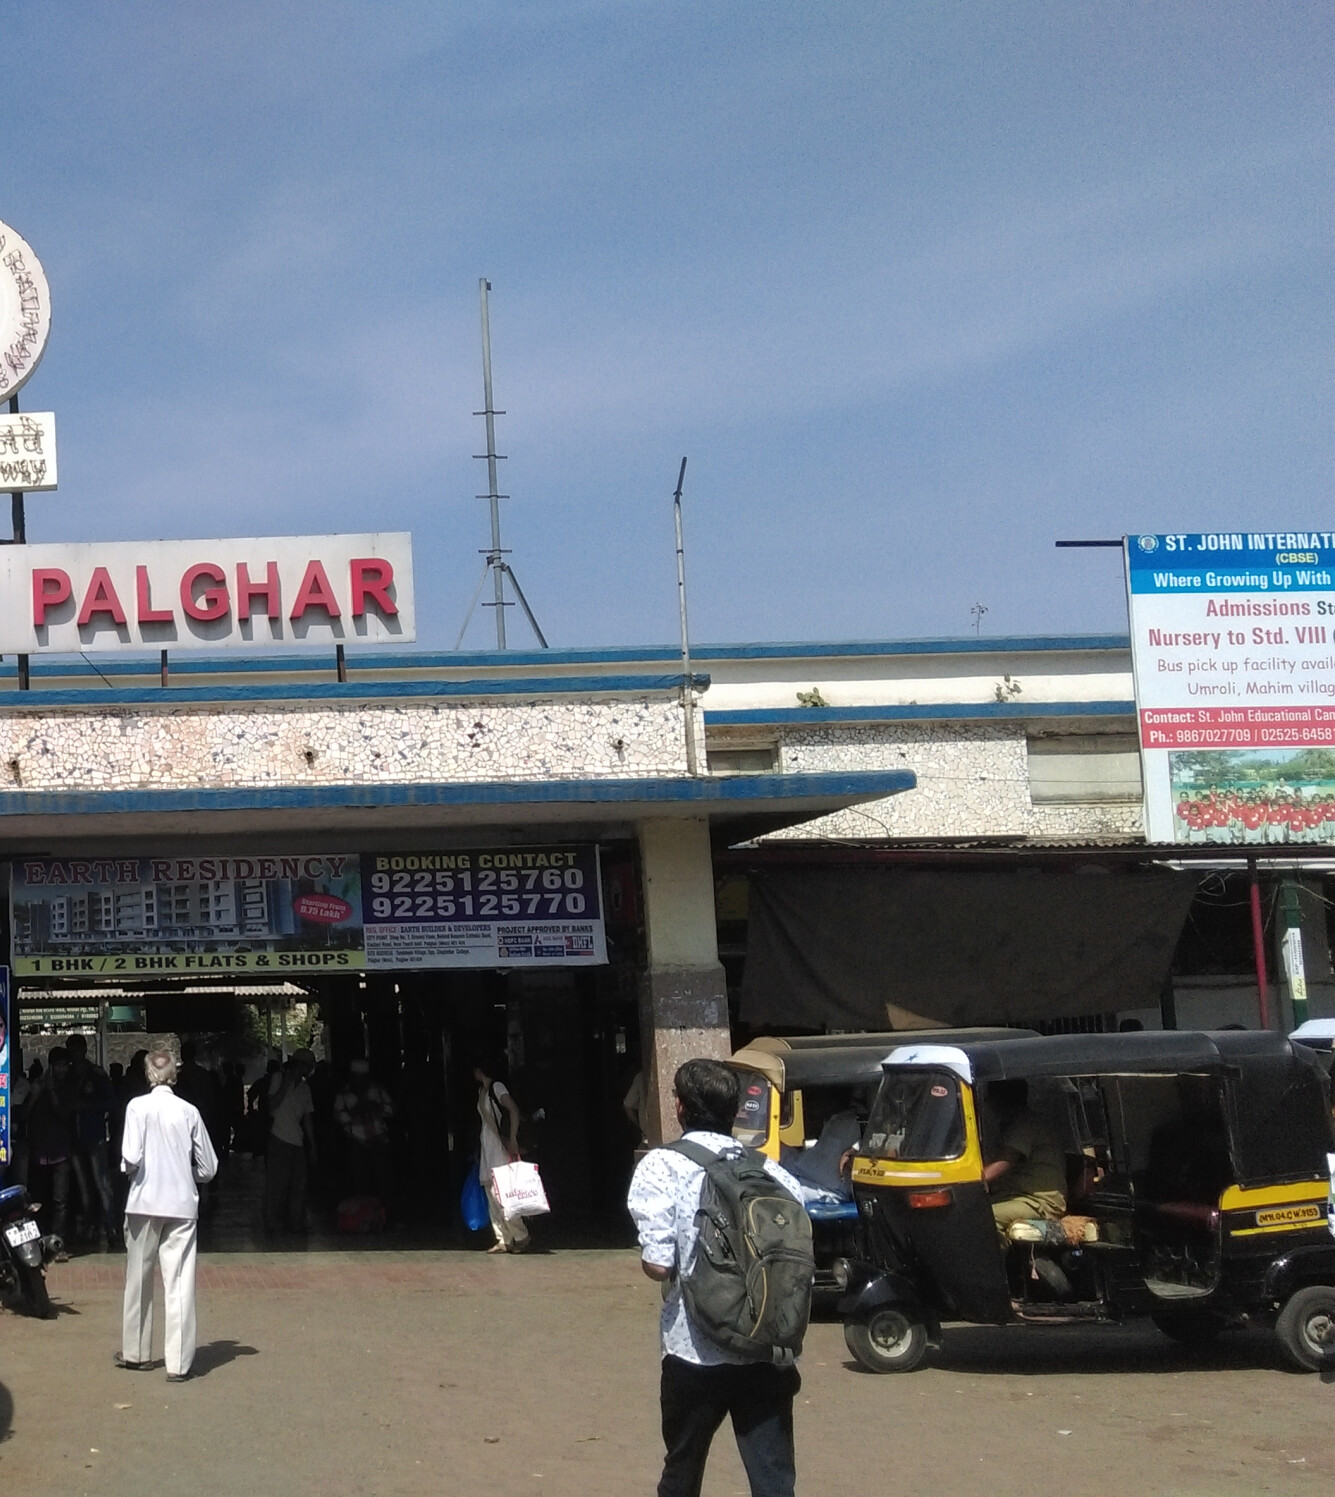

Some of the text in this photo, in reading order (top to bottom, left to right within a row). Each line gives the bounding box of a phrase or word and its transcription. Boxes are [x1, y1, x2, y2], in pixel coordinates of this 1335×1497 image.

[1165, 535, 1192, 551] ST.
[1197, 534, 1244, 550] JOHN
[1275, 552, 1319, 565] (CBSE)
[1153, 570, 1331, 589] Where Growing Up With
[32, 556, 401, 628] PALGHAR
[1206, 599, 1335, 617] Admissions St
[1148, 626, 1326, 650] Nursery to Std. VIII
[1157, 656, 1335, 675] Bus pick up facility avail
[1187, 683, 1241, 697] Umroli,
[1246, 681, 1293, 695] Mahim
[1144, 711, 1195, 724] Contact:
[1198, 710, 1215, 723] St.
[1218, 710, 1244, 723] John
[1248, 708, 1311, 722] Educational
[1150, 730, 1174, 743] Ph.:
[1176, 729, 1251, 743] 9867027709
[376, 852, 577, 871] BOOKING CONTACT
[25, 856, 347, 885] EARTH RESIDENCY
[371, 868, 584, 893] 9225125760
[300, 905, 318, 915] 9.75
[301, 898, 347, 911] Starting From
[372, 893, 586, 918] 9225125770
[401, 925, 420, 933] EARTH
[454, 924, 491, 932] DEVELOPERS
[497, 925, 593, 934] PROJECT APPROVED BY BANKS
[572, 936, 593, 949] DHFL
[33, 953, 349, 972] 1 BHK / 2 BHK FLATS & SHOPS
